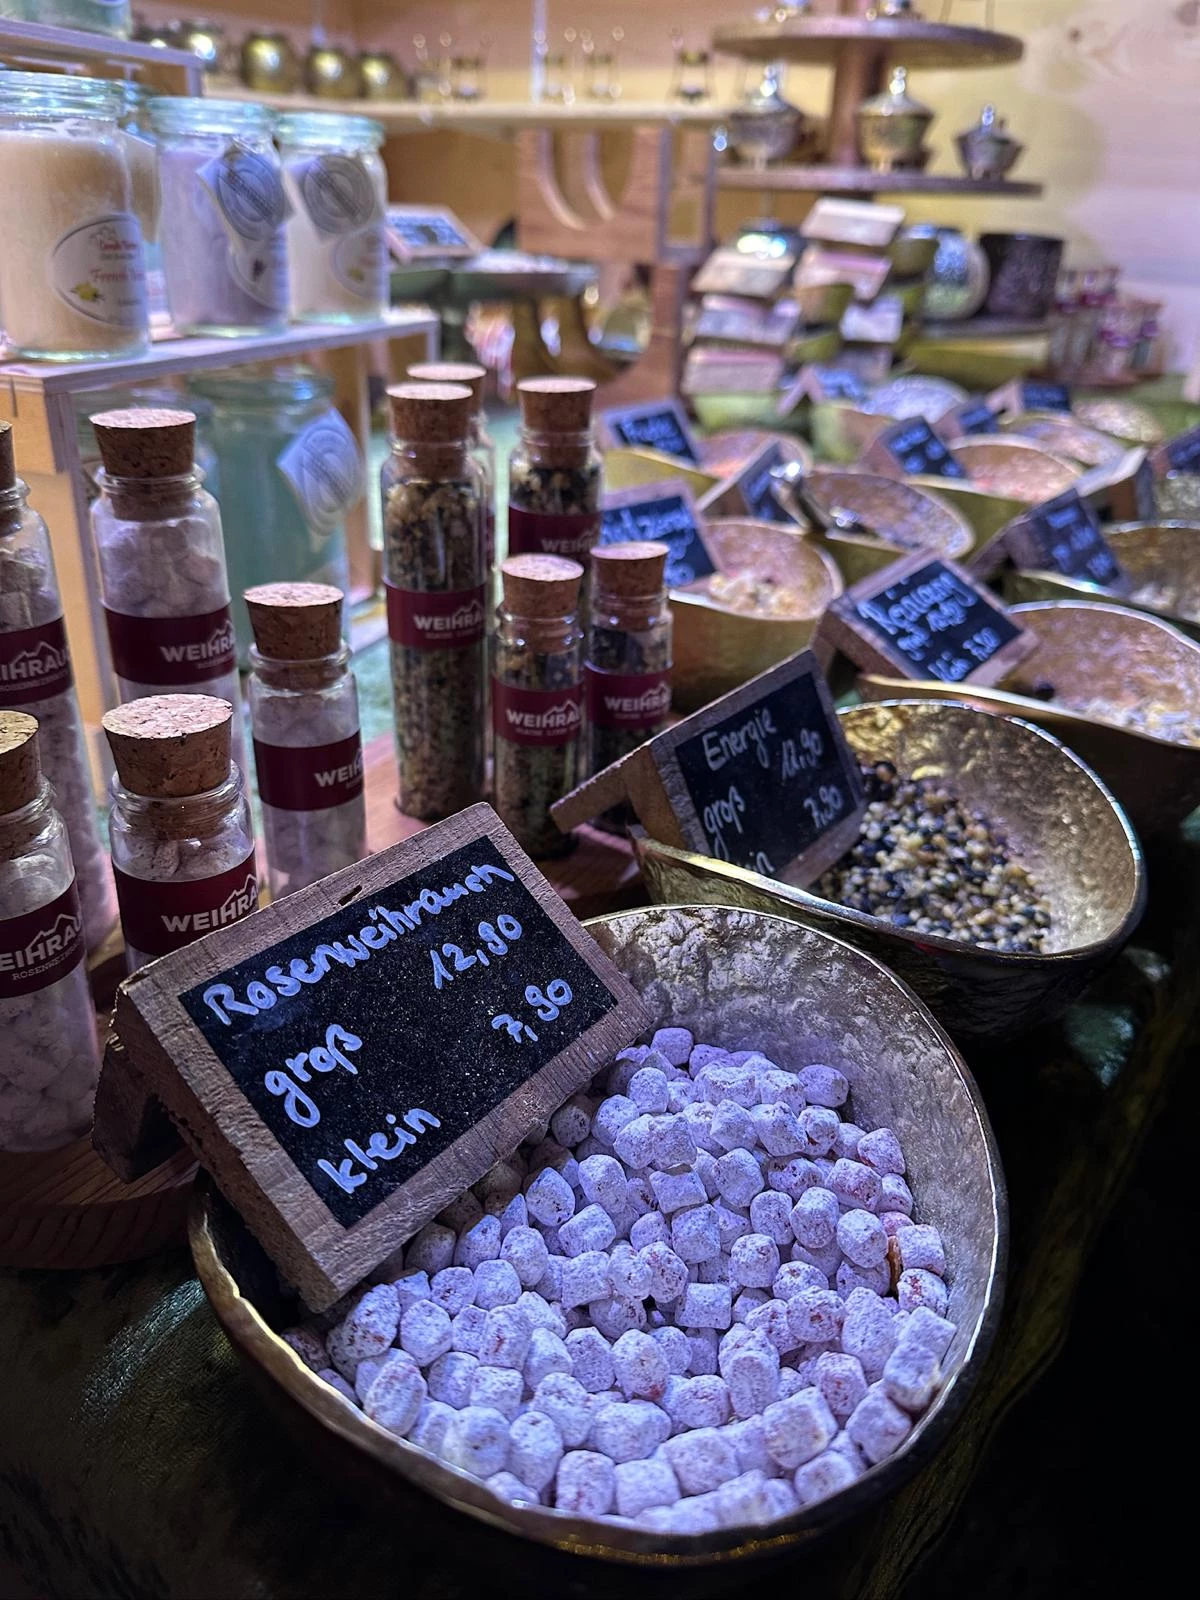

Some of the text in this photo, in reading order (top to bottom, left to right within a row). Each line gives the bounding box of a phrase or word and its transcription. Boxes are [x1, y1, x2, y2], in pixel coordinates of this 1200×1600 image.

[702, 707, 777, 772] Energie
[202, 863, 515, 1026] Rosenweihrauch
[264, 913, 524, 1128] groß 12,90
[317, 977, 574, 1195] klein 7,90
